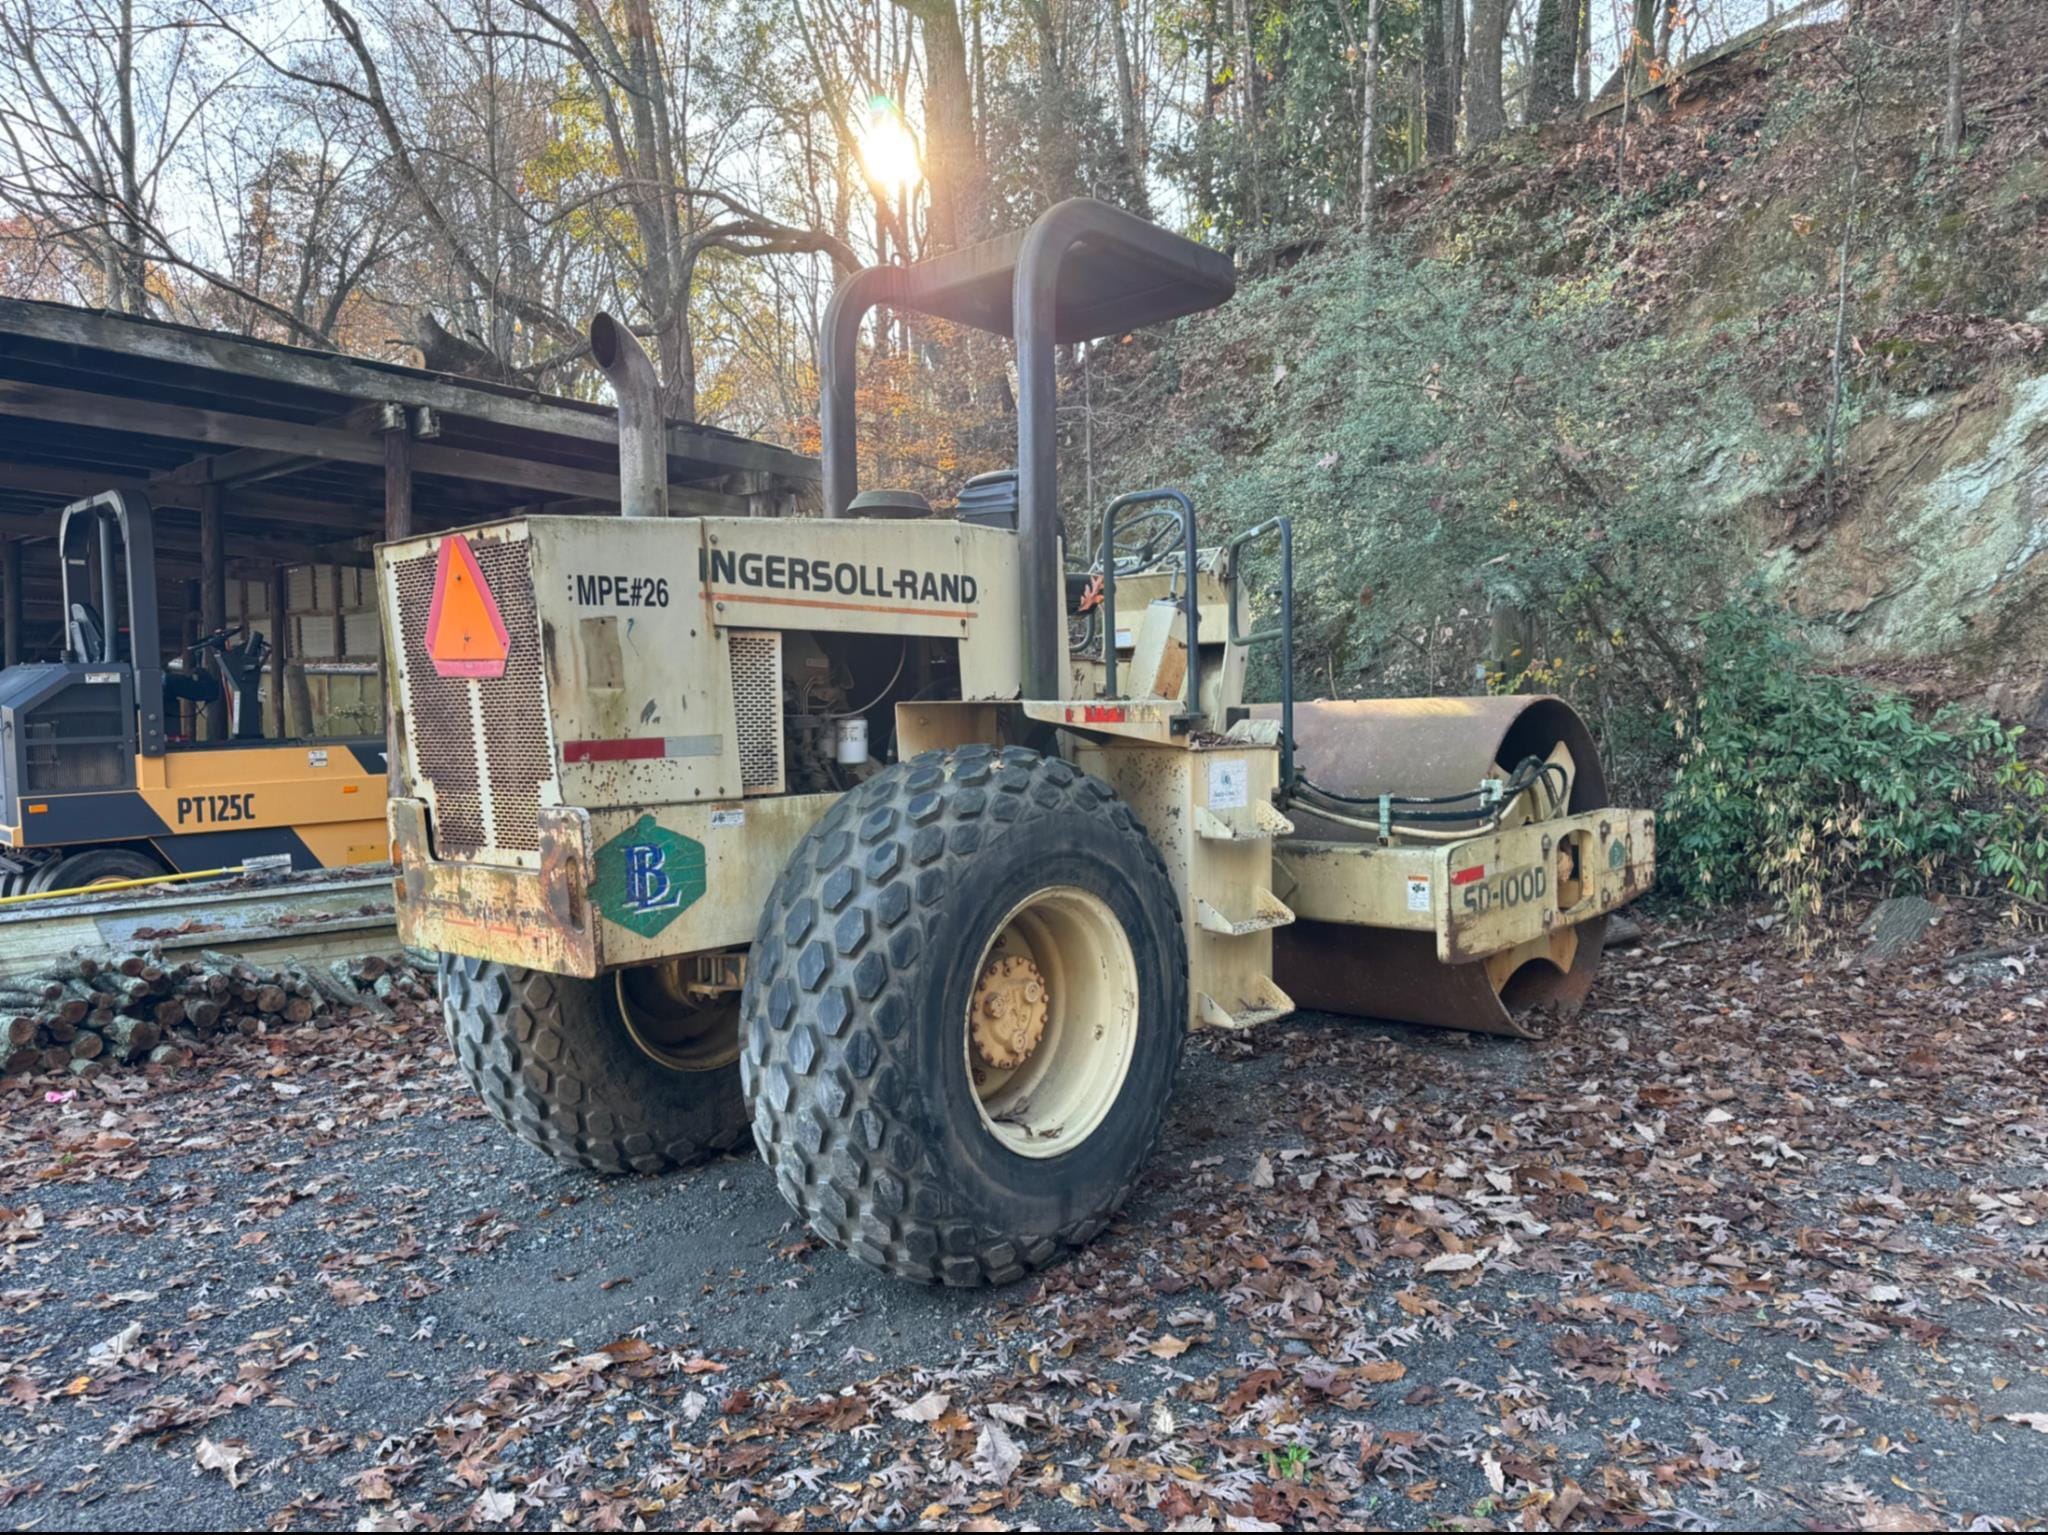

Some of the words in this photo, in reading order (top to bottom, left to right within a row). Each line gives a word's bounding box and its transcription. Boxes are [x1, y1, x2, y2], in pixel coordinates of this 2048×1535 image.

[576, 574, 669, 608] MPE#26
[699, 547, 978, 604] INGERSOLL-RAND
[177, 793, 256, 824] PT125C
[1463, 866, 1547, 913] SD-100D
